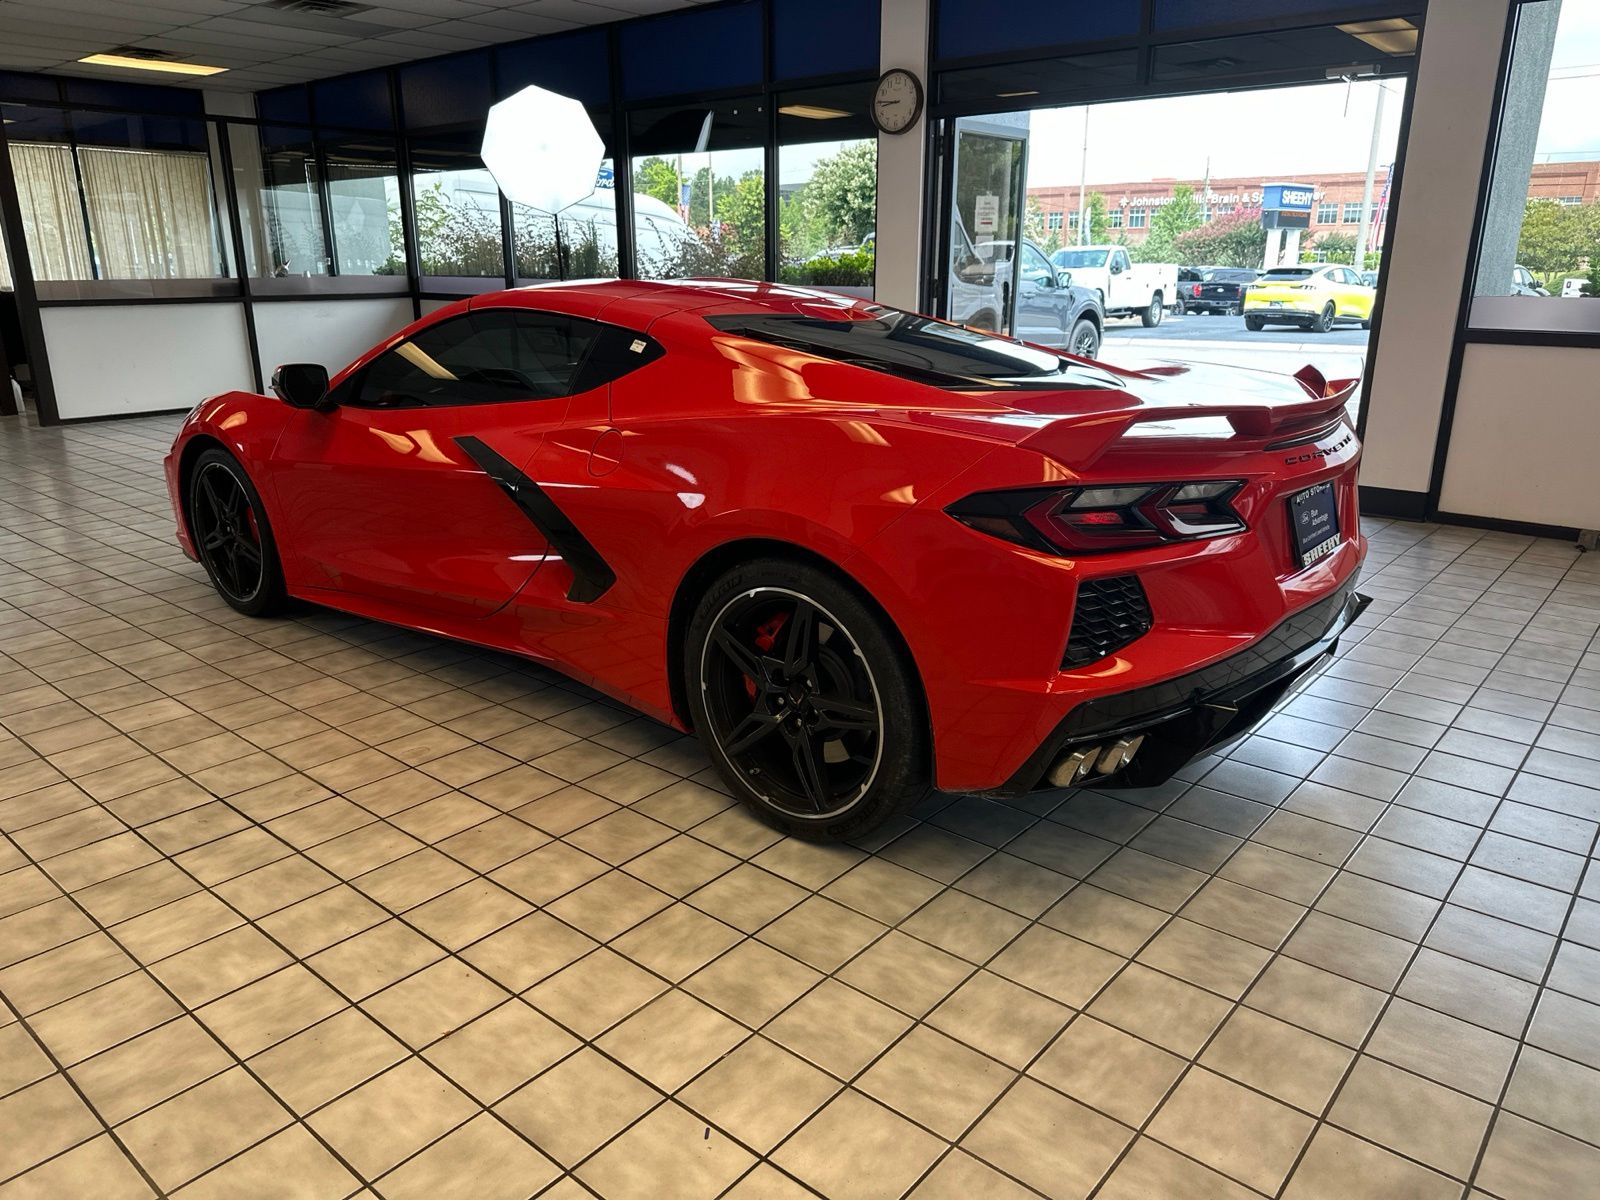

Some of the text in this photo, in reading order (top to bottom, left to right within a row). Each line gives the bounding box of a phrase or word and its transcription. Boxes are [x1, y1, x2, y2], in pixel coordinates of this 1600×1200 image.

[1130, 196, 1177, 207] Johnston
[1210, 193, 1239, 204] Brain
[1241, 192, 1250, 203] &
[1281, 190, 1313, 205] SHEEHY
[1296, 490, 1310, 504] AUTO
[1303, 532, 1341, 566] SHEEHY
